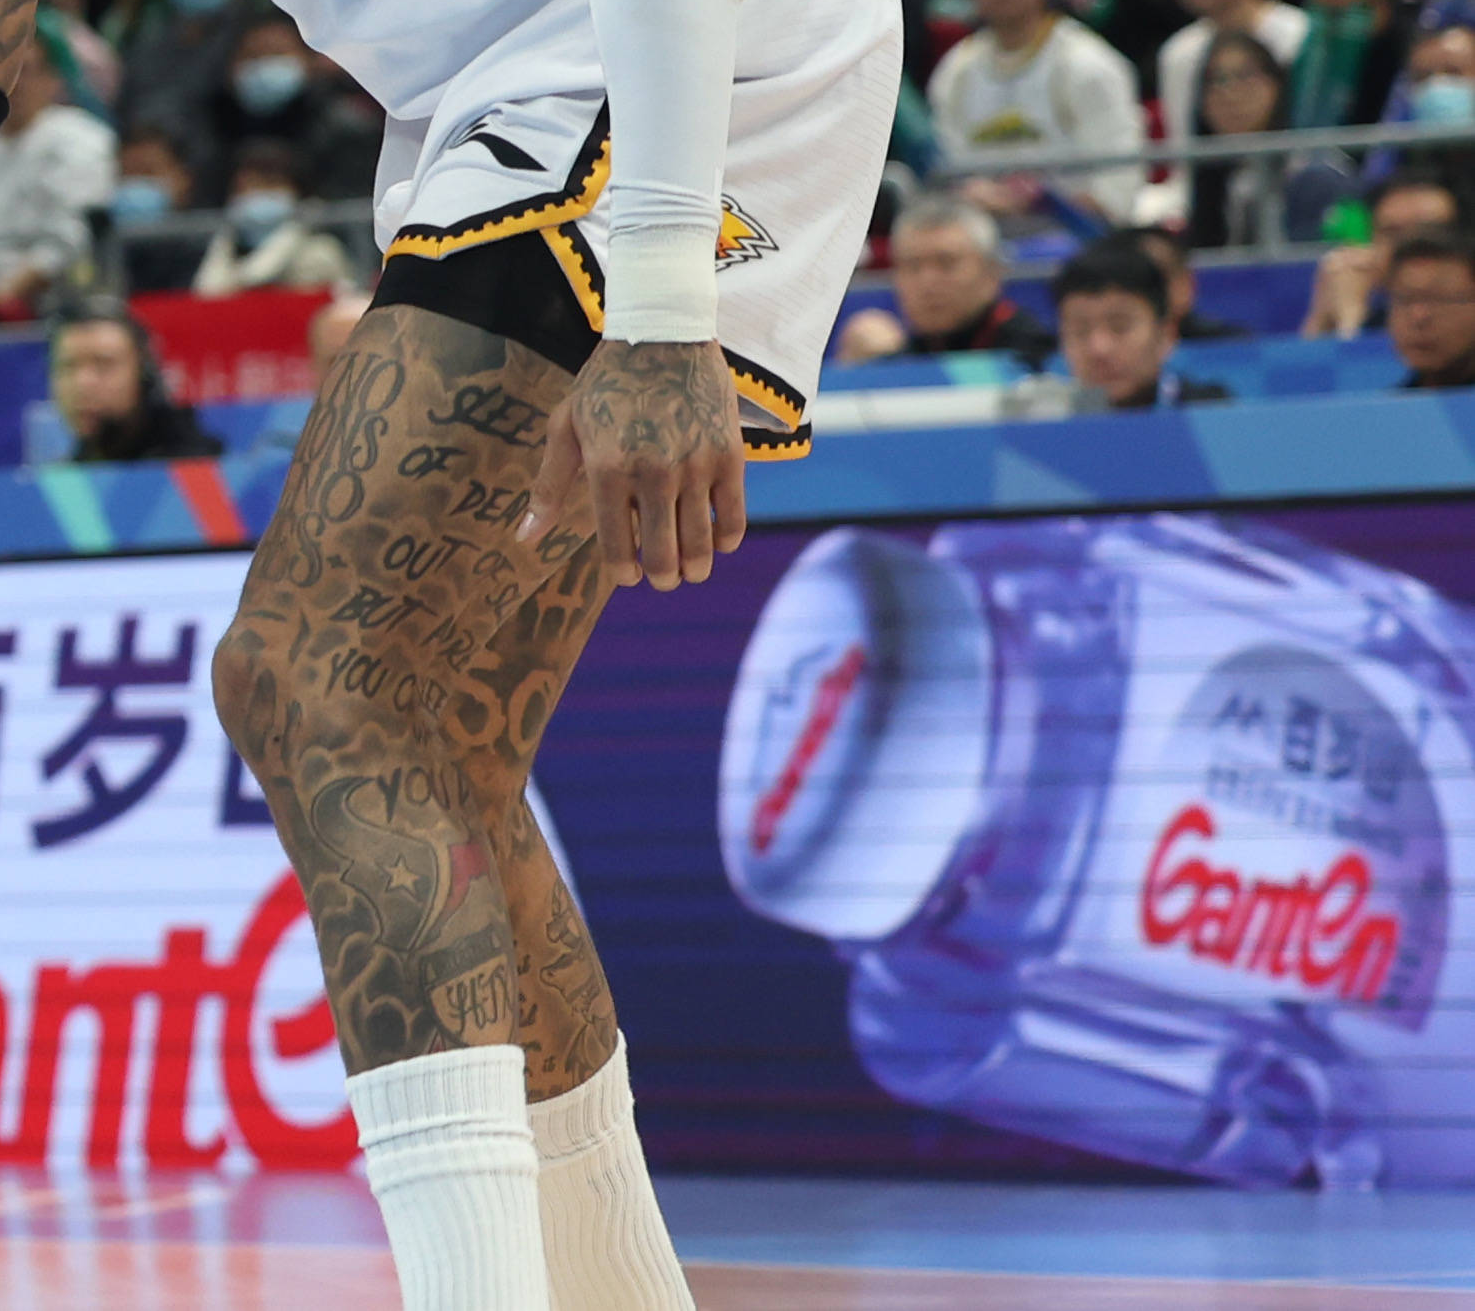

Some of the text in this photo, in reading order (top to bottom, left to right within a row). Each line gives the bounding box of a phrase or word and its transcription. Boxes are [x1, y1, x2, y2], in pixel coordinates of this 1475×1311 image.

[428, 384, 550, 449] SLEE
[383, 534, 481, 581] OUT
[329, 583, 438, 633] BUT
[324, 647, 389, 700] YOU
